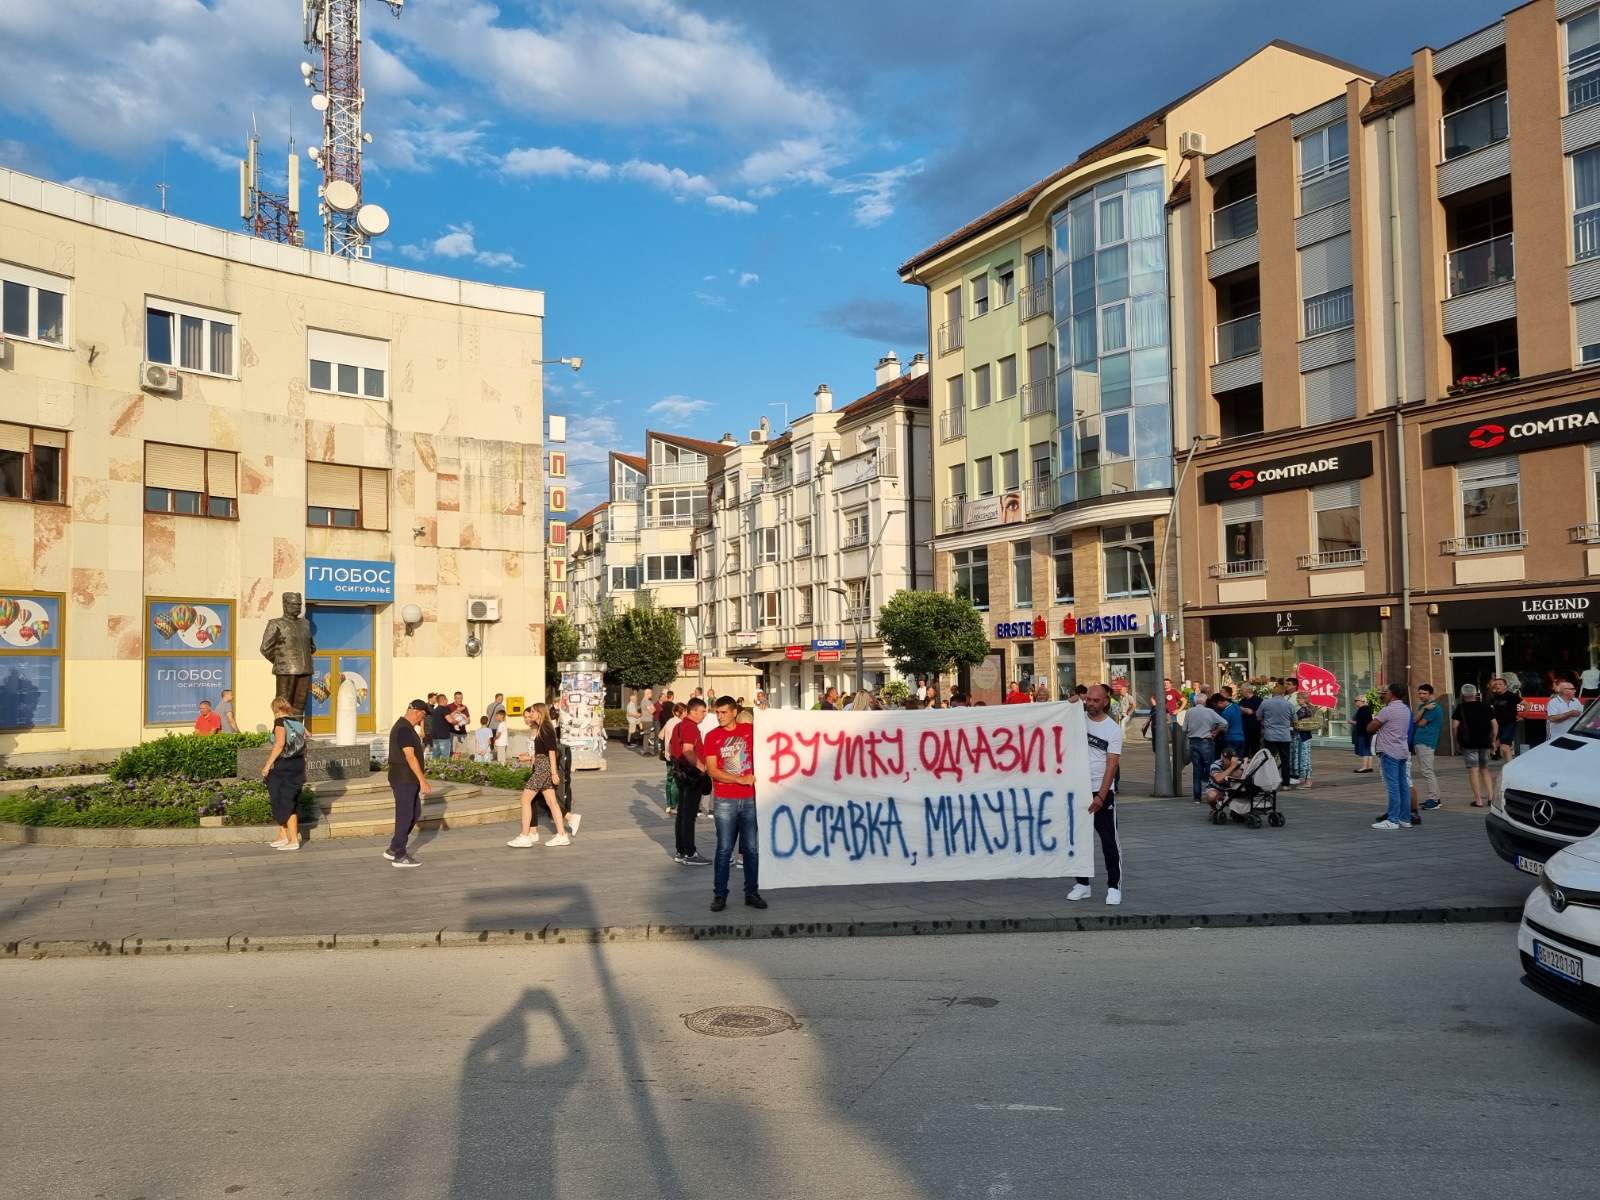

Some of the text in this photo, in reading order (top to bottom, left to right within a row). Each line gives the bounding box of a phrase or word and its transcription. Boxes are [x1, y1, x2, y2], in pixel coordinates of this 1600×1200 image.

[1509, 411, 1600, 438] COMTRA
[1256, 457, 1339, 482] COMTRADE
[552, 455, 565, 615] ПОШТА
[309, 566, 391, 584] ГЛОБОС
[334, 585, 391, 594] ОСИГУРАЊЕ
[1522, 597, 1590, 612] LEGEND
[996, 613, 1137, 639] ERSTE LEASING
[1527, 613, 1559, 621] WORLD
[157, 669, 223, 681] ГЛОБОС
